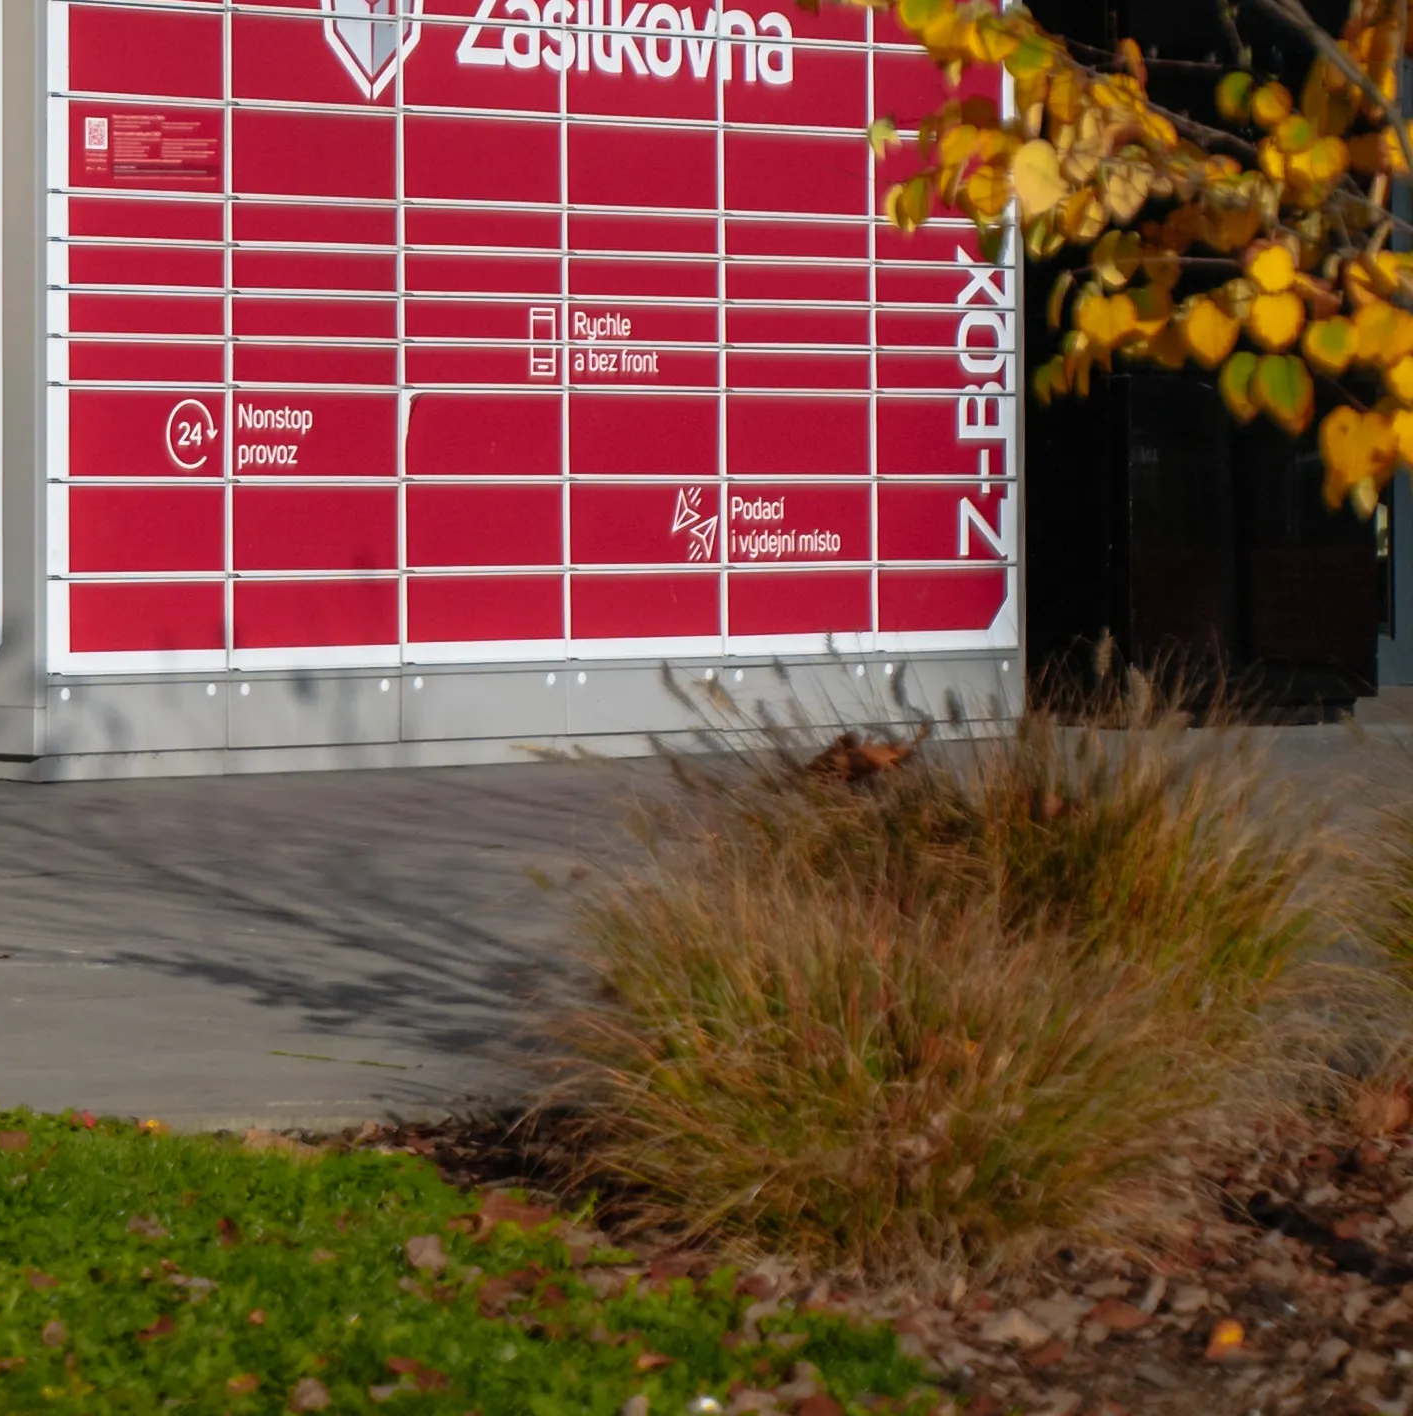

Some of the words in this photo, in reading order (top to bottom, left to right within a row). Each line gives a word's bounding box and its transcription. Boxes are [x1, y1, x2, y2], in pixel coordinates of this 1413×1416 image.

[574, 311, 631, 341] Rychle
[575, 353, 584, 371] a
[589, 348, 618, 371] bez
[622, 349, 659, 373] front
[957, 245, 1007, 558] Z-BOX
[238, 403, 313, 434] Nonstop
[178, 421, 202, 446] 24
[238, 444, 298, 469] provoz
[731, 496, 785, 520] Podací
[732, 530, 736, 552] i
[739, 529, 796, 558] výdejní
[799, 529, 841, 552] místo
